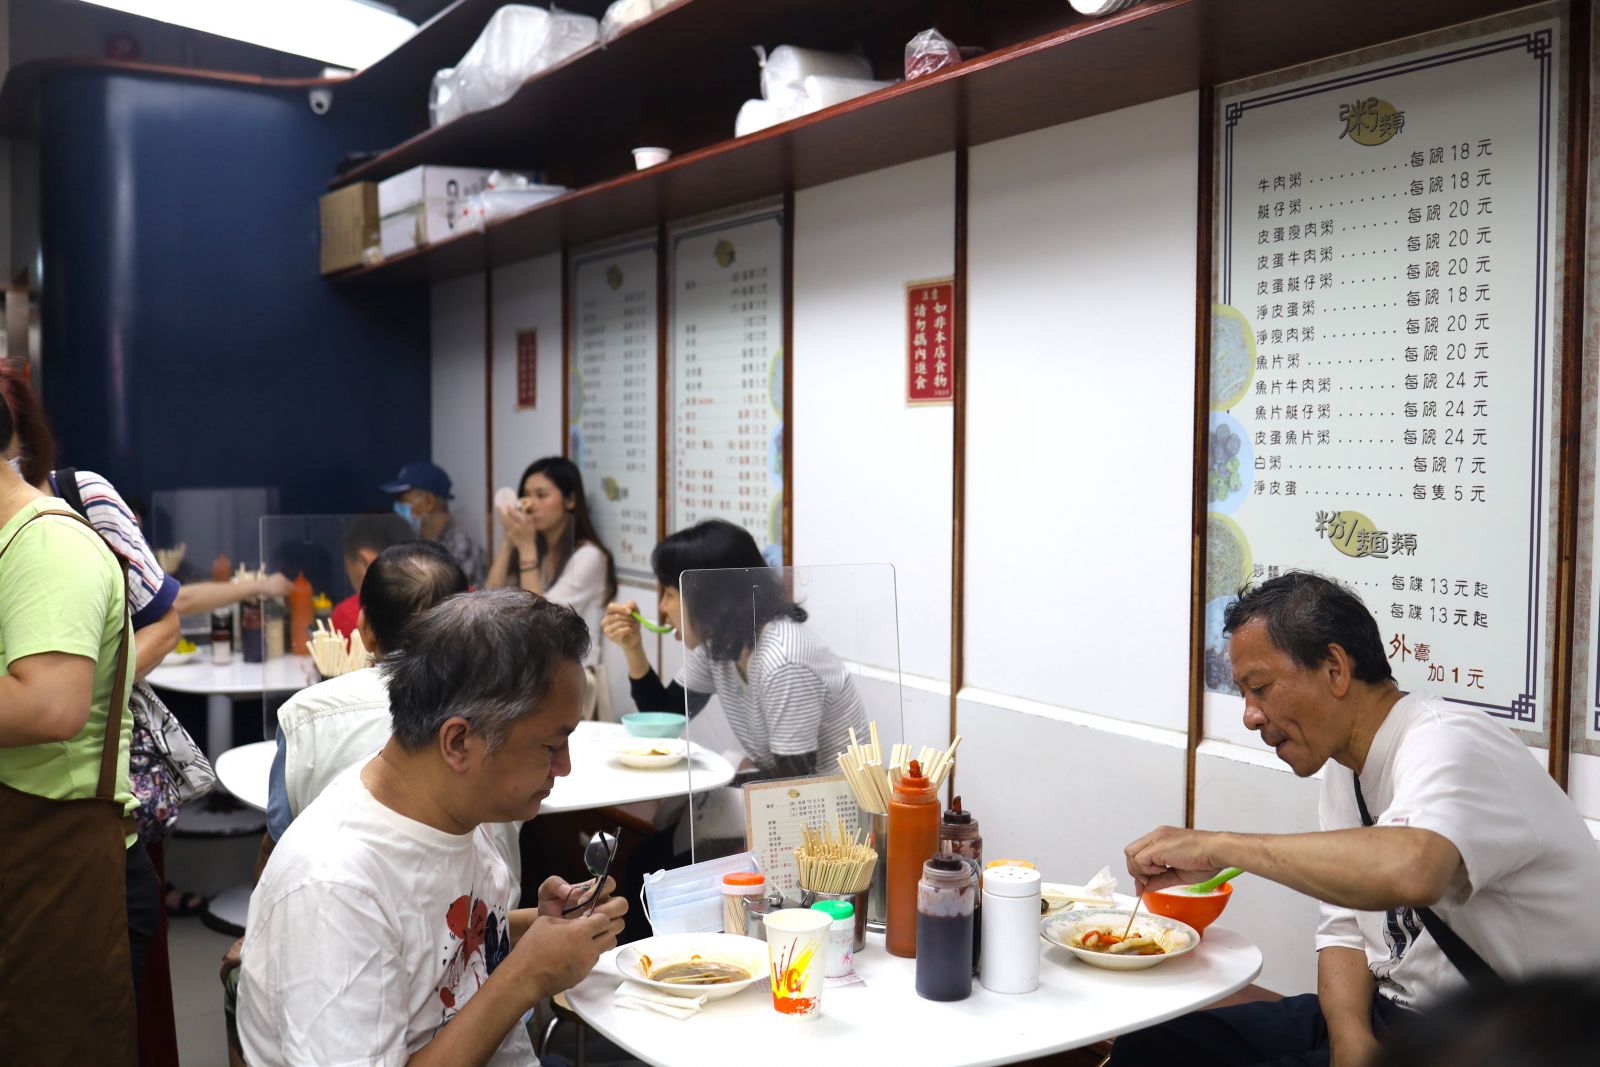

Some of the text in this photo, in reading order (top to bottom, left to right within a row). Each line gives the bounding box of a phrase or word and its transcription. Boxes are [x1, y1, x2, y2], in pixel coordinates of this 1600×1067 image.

[1339, 96, 1406, 139] 粥類
[1259, 172, 1301, 193] 牛肉粥
[1258, 219, 1333, 245] 皮蛋瘦肉粥
[1257, 246, 1334, 270] 皮蛋牛肉粥
[933, 302, 947, 388] 如非本店食物
[1256, 353, 1302, 370] 魚片粥
[1256, 377, 1330, 395] 魚片牛肉粥
[1255, 429, 1330, 447] 皮蛋魚片粥
[1255, 455, 1281, 471] 白粥
[1389, 633, 1431, 662] 外賣
